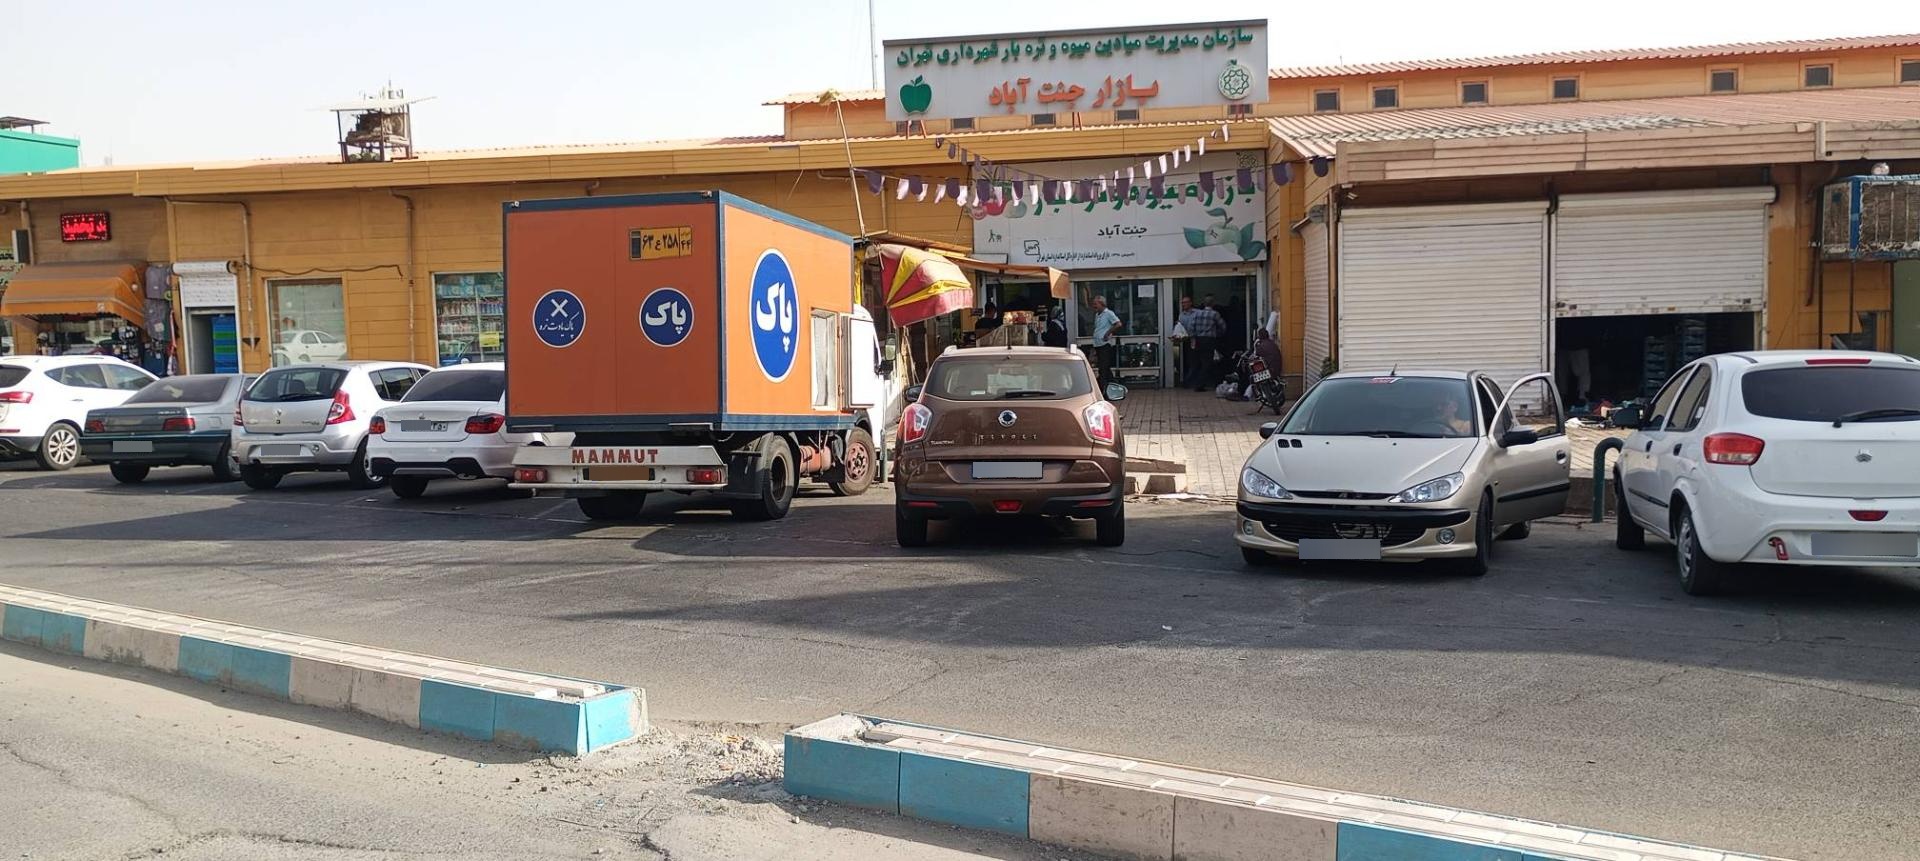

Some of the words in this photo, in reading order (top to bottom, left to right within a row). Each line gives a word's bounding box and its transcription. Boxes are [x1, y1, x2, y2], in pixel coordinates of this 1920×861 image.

[1002, 38, 1020, 62] بار
[1025, 37, 1045, 61] تره
[1061, 40, 1091, 58] میوه
[1095, 33, 1141, 57] میادین
[1145, 31, 1199, 53] مدیریت
[1203, 28, 1253, 50] سازمان
[897, 44, 933, 66] تهران
[937, 41, 998, 65] شهرداری
[1050, 44, 1056, 60] و
[989, 77, 1031, 112] آباد
[1037, 81, 1086, 109] جنت
[1093, 73, 1159, 108] بازار
[1097, 225, 1120, 239] آباد
[1122, 226, 1147, 238] جنت
[564, 311, 580, 339] پاک
[645, 301, 687, 335] پاک
[756, 282, 793, 353] پاک
[572, 448, 658, 464] MAMMUT
